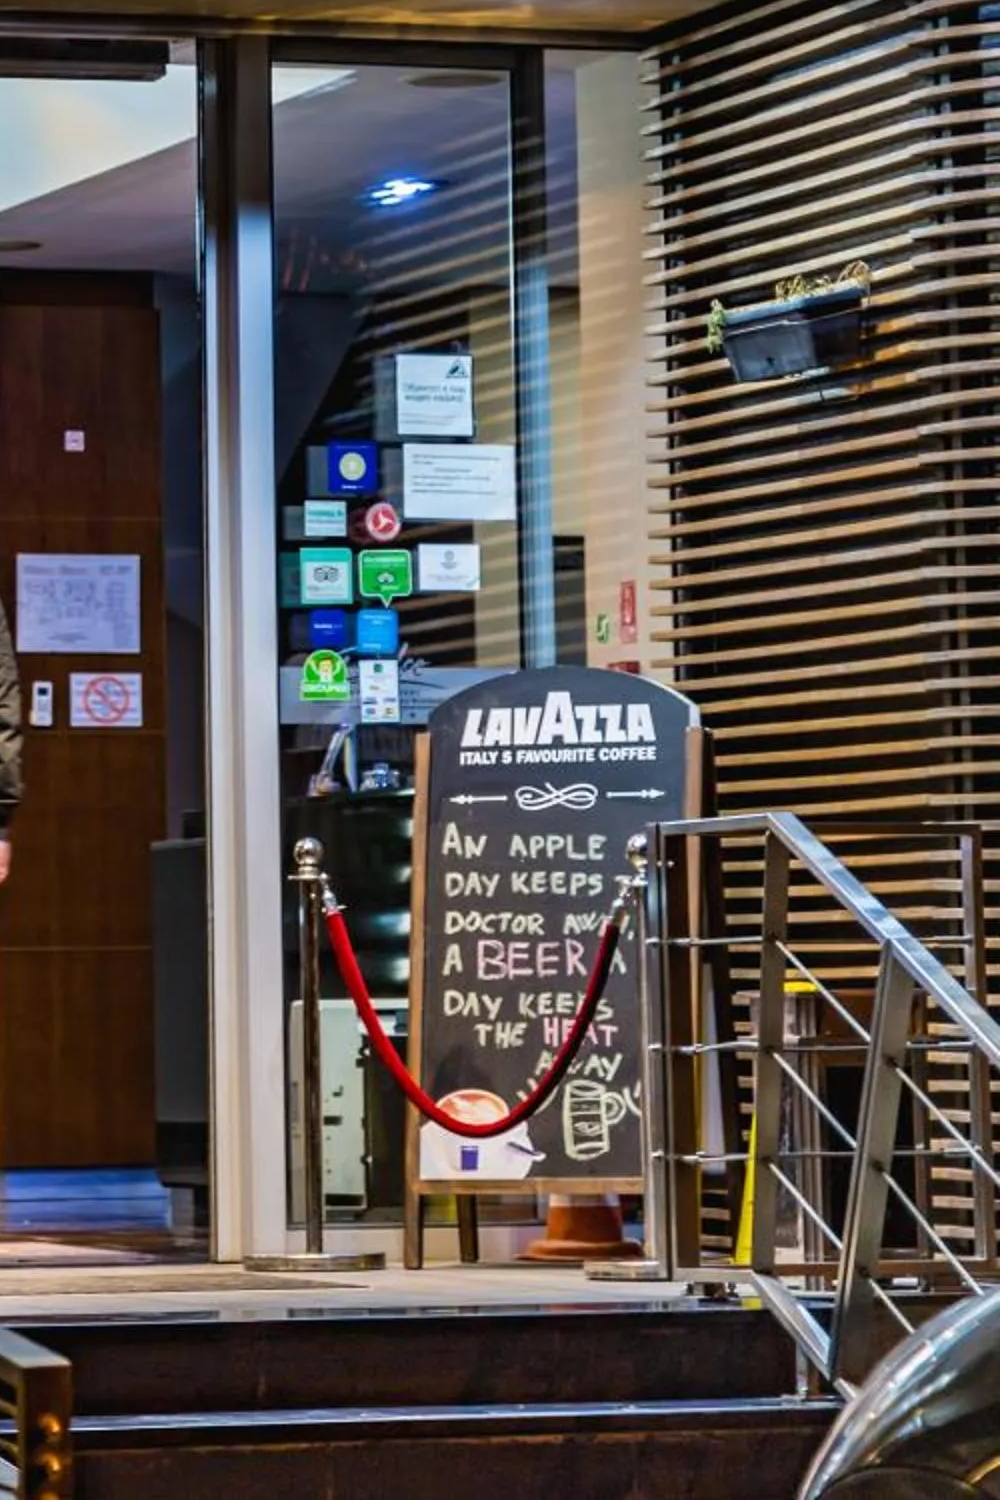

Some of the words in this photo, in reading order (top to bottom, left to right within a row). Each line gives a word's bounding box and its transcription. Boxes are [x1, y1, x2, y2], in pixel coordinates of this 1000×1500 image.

[459, 691, 657, 748] LAVAZZA
[516, 748, 595, 764] FAVOURITE
[598, 746, 657, 762] COFFEE
[442, 821, 487, 859] AN
[509, 833, 607, 860] APPLE
[444, 871, 500, 897] DAY
[510, 871, 604, 897] KEEPS
[444, 910, 545, 936] DOCTOR
[442, 943, 463, 976] A
[477, 938, 588, 981] BEER
[443, 989, 502, 1020] DAY
[474, 1021, 527, 1048] THE
